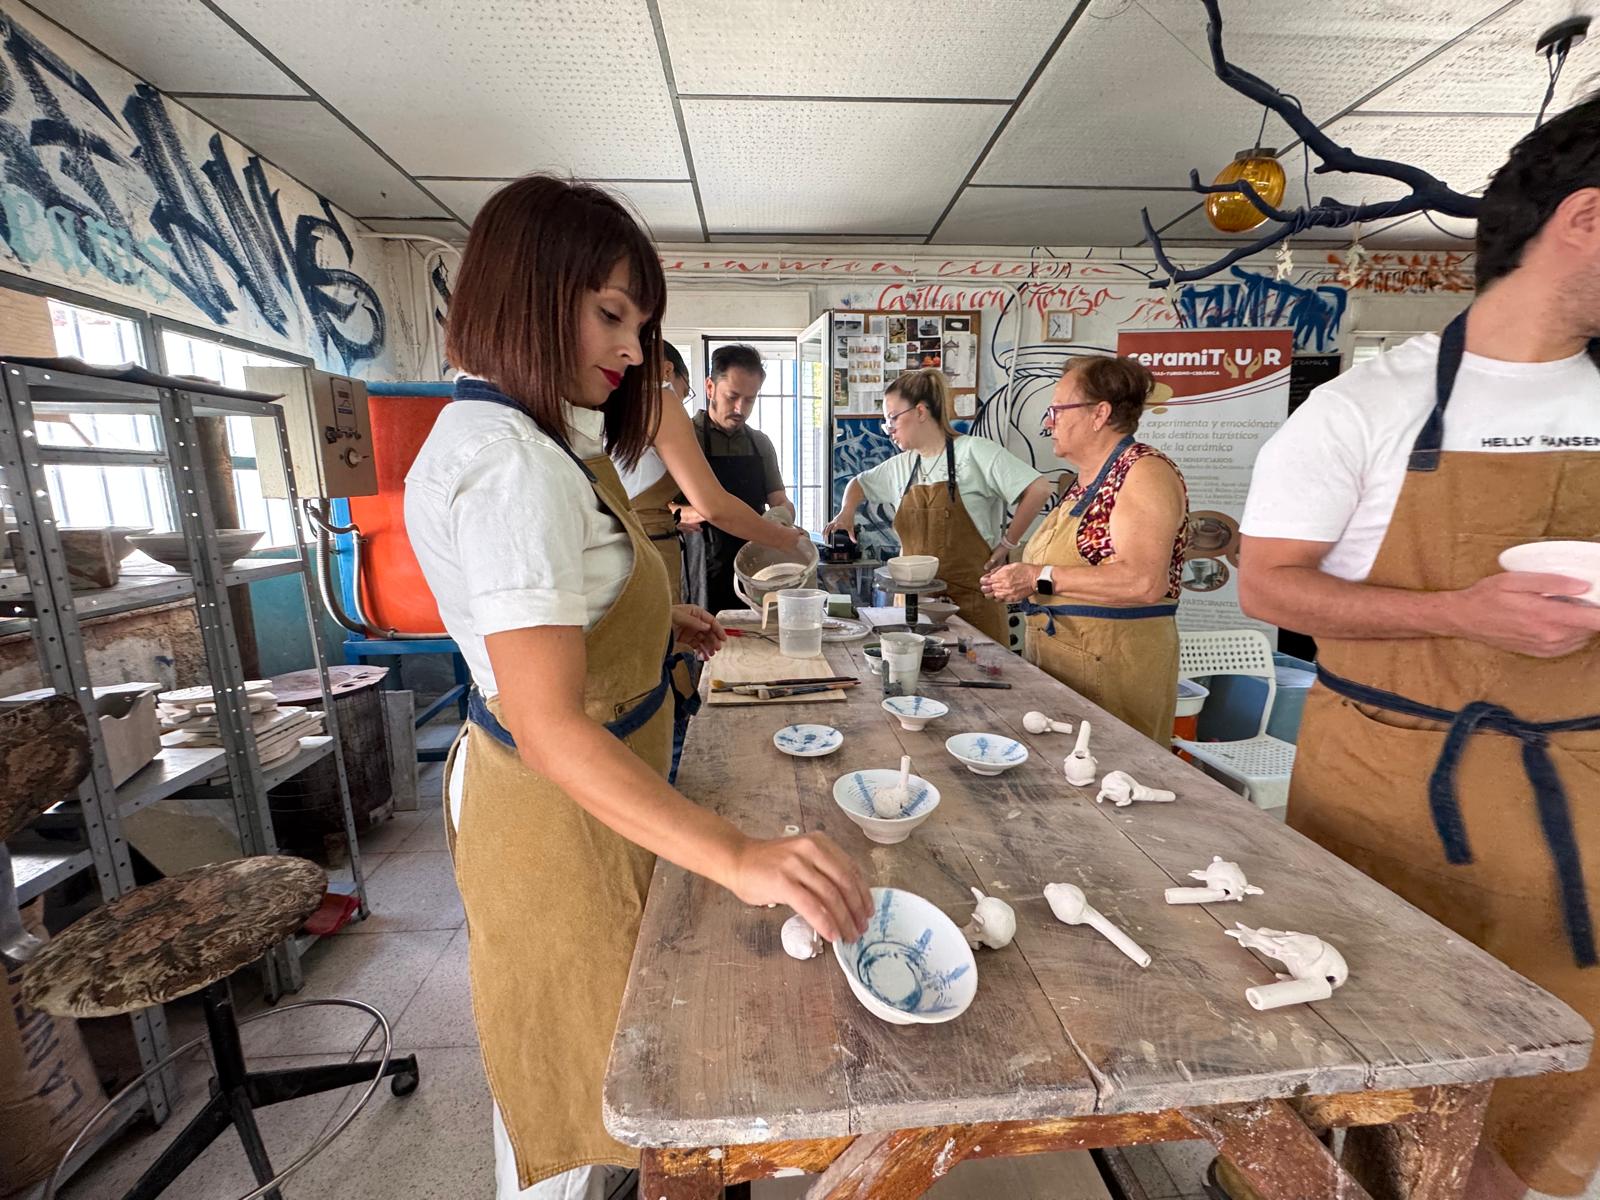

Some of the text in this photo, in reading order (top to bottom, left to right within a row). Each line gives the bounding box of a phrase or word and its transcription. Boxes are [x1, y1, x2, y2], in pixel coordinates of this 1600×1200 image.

[1152, 430, 1166, 440] los
[1168, 430, 1209, 440] destinos
[1481, 436, 1534, 447] HELLY
[1160, 443, 1172, 451] de
[1175, 443, 1184, 451] la
